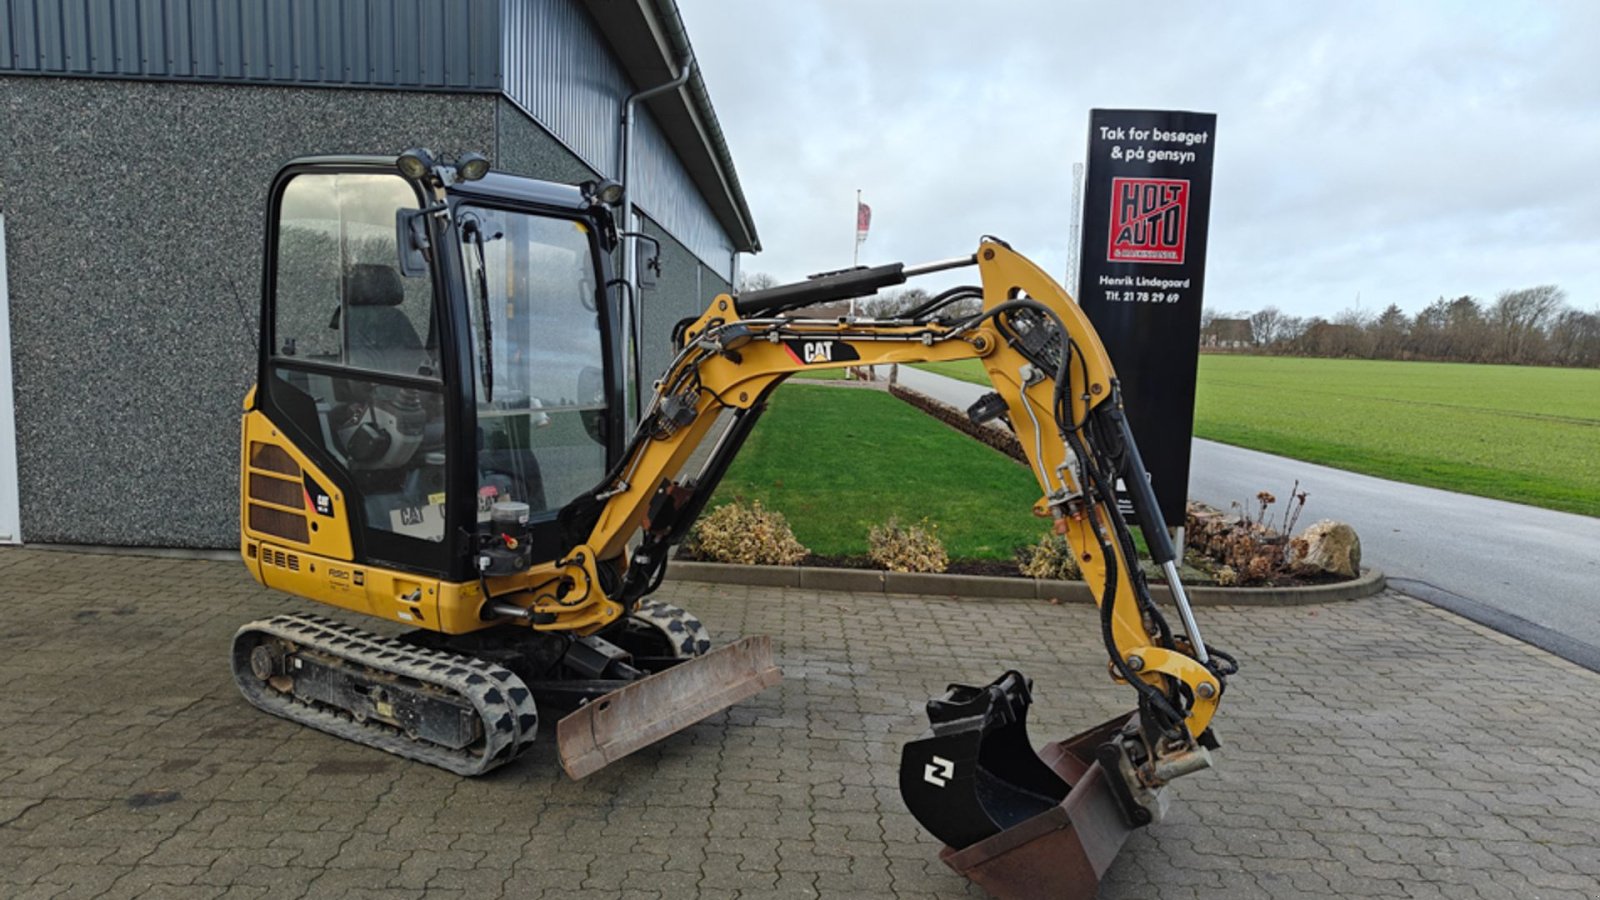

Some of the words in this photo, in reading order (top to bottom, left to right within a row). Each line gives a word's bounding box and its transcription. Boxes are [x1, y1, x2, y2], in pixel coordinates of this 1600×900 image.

[1100, 126, 1125, 140] Tak
[1129, 127, 1150, 140] for
[1153, 127, 1208, 146] besøget
[1111, 145, 1122, 159] &
[1125, 146, 1144, 162] på
[1147, 149, 1195, 164] gensyn
[1119, 182, 1183, 226] HOLT
[1115, 202, 1182, 247] AUTO
[1099, 275, 1133, 286] Henrik
[1136, 276, 1190, 289] Lindegaard
[1123, 291, 1135, 302] 21
[1136, 292, 1149, 302] 78
[1151, 293, 1165, 302] 29
[1166, 293, 1180, 303] 69
[804, 341, 833, 363] CAT
